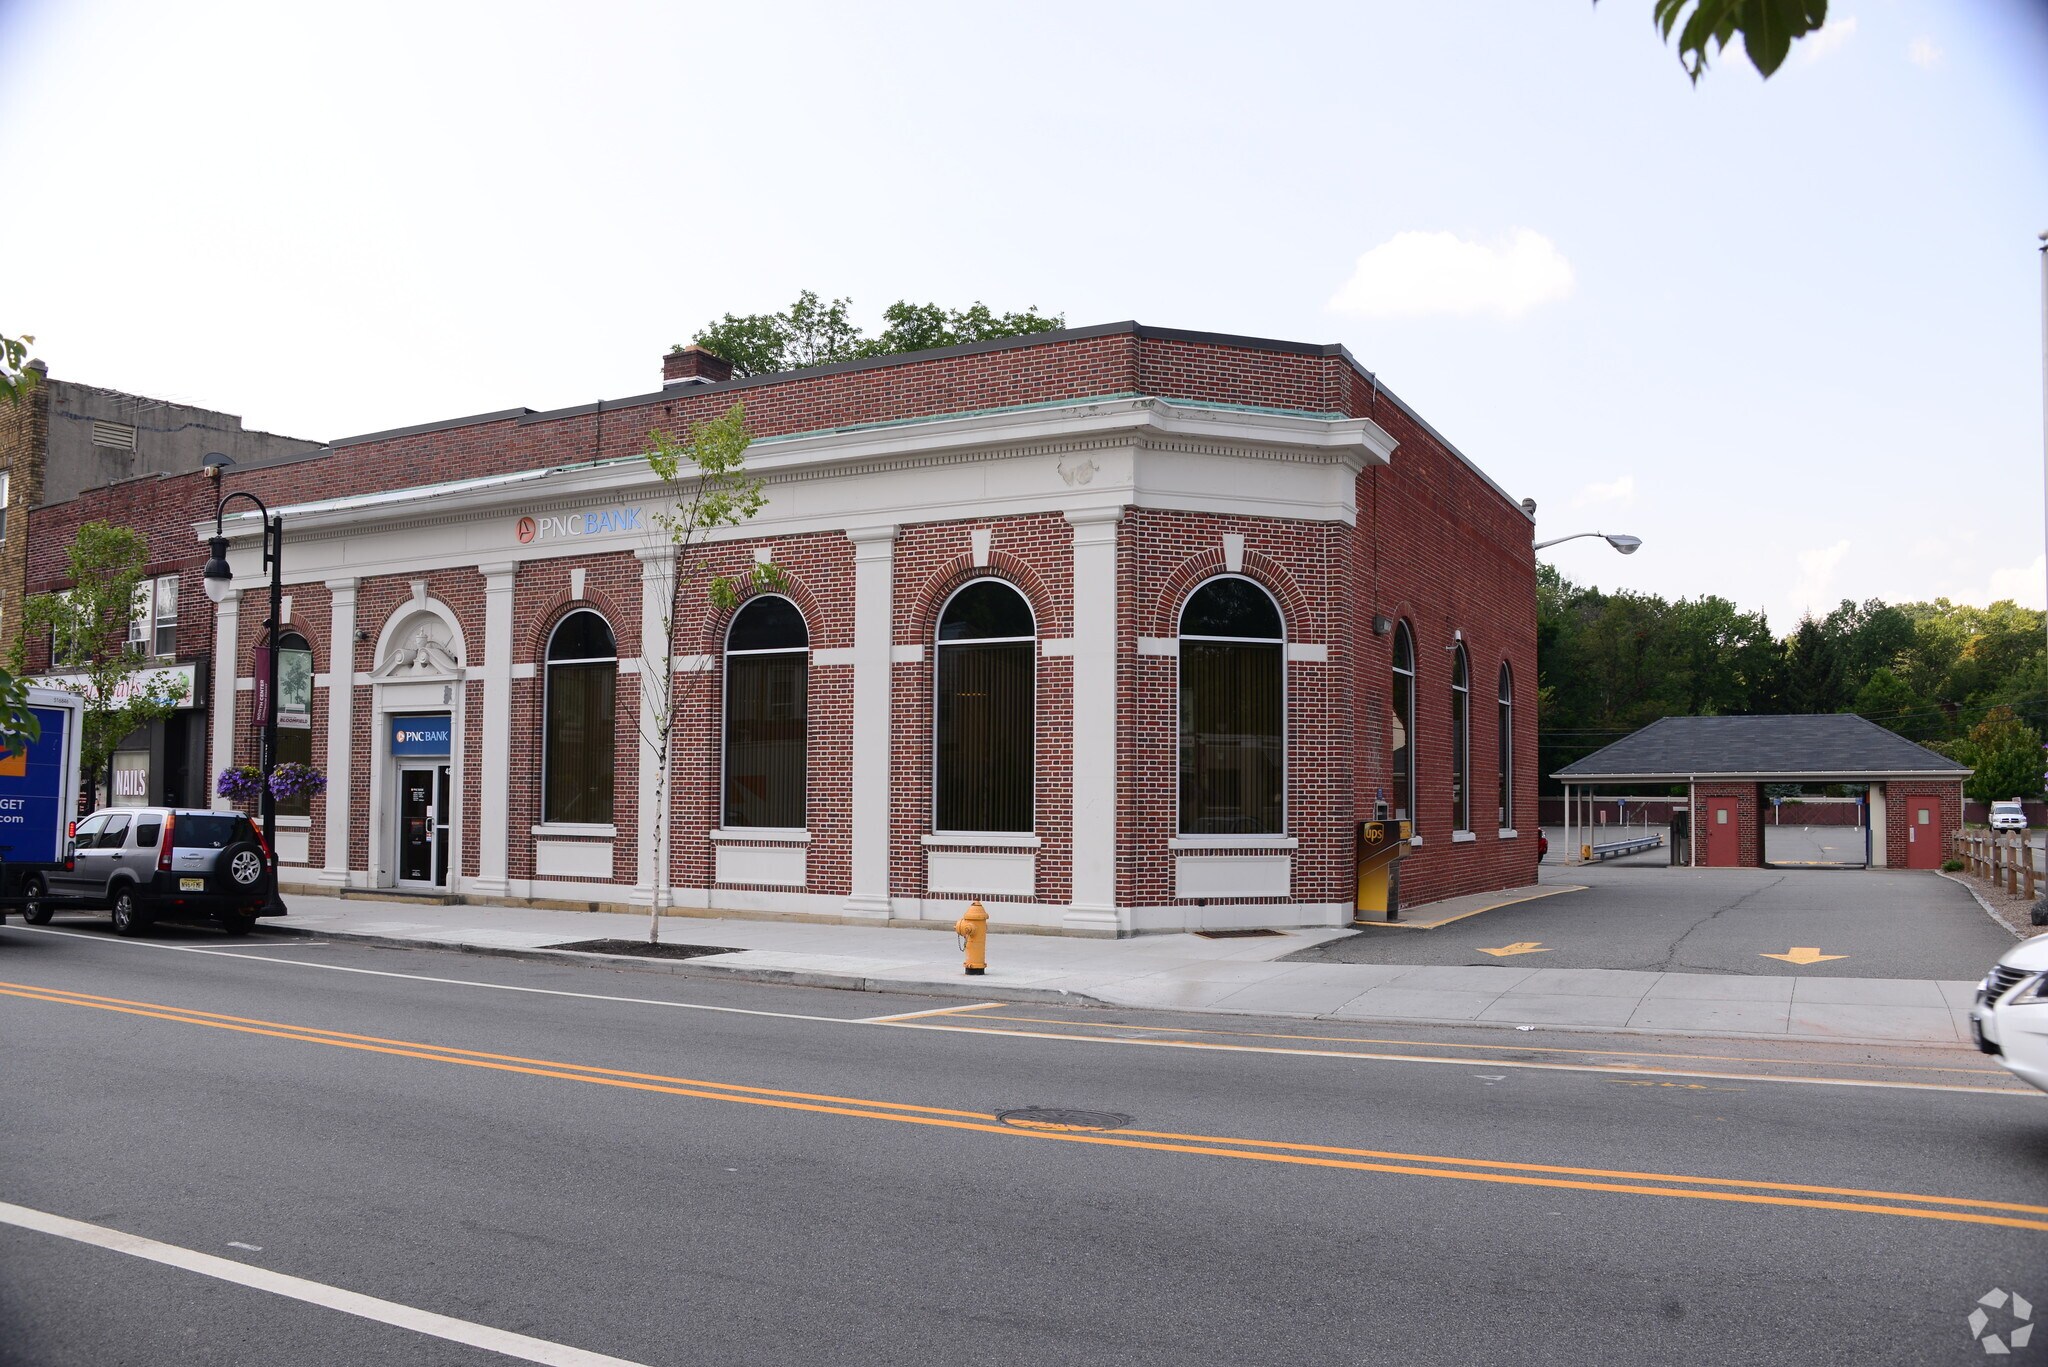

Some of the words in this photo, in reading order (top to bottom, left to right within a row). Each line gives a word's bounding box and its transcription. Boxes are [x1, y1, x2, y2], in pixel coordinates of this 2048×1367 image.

[538, 514, 582, 539] PNC
[583, 507, 641, 534] BANK
[256, 701, 264, 720] NORTH
[406, 731, 425, 741] PNC
[425, 730, 449, 741] BANK
[116, 769, 146, 796] NAILS
[1366, 829, 1383, 842] ups
